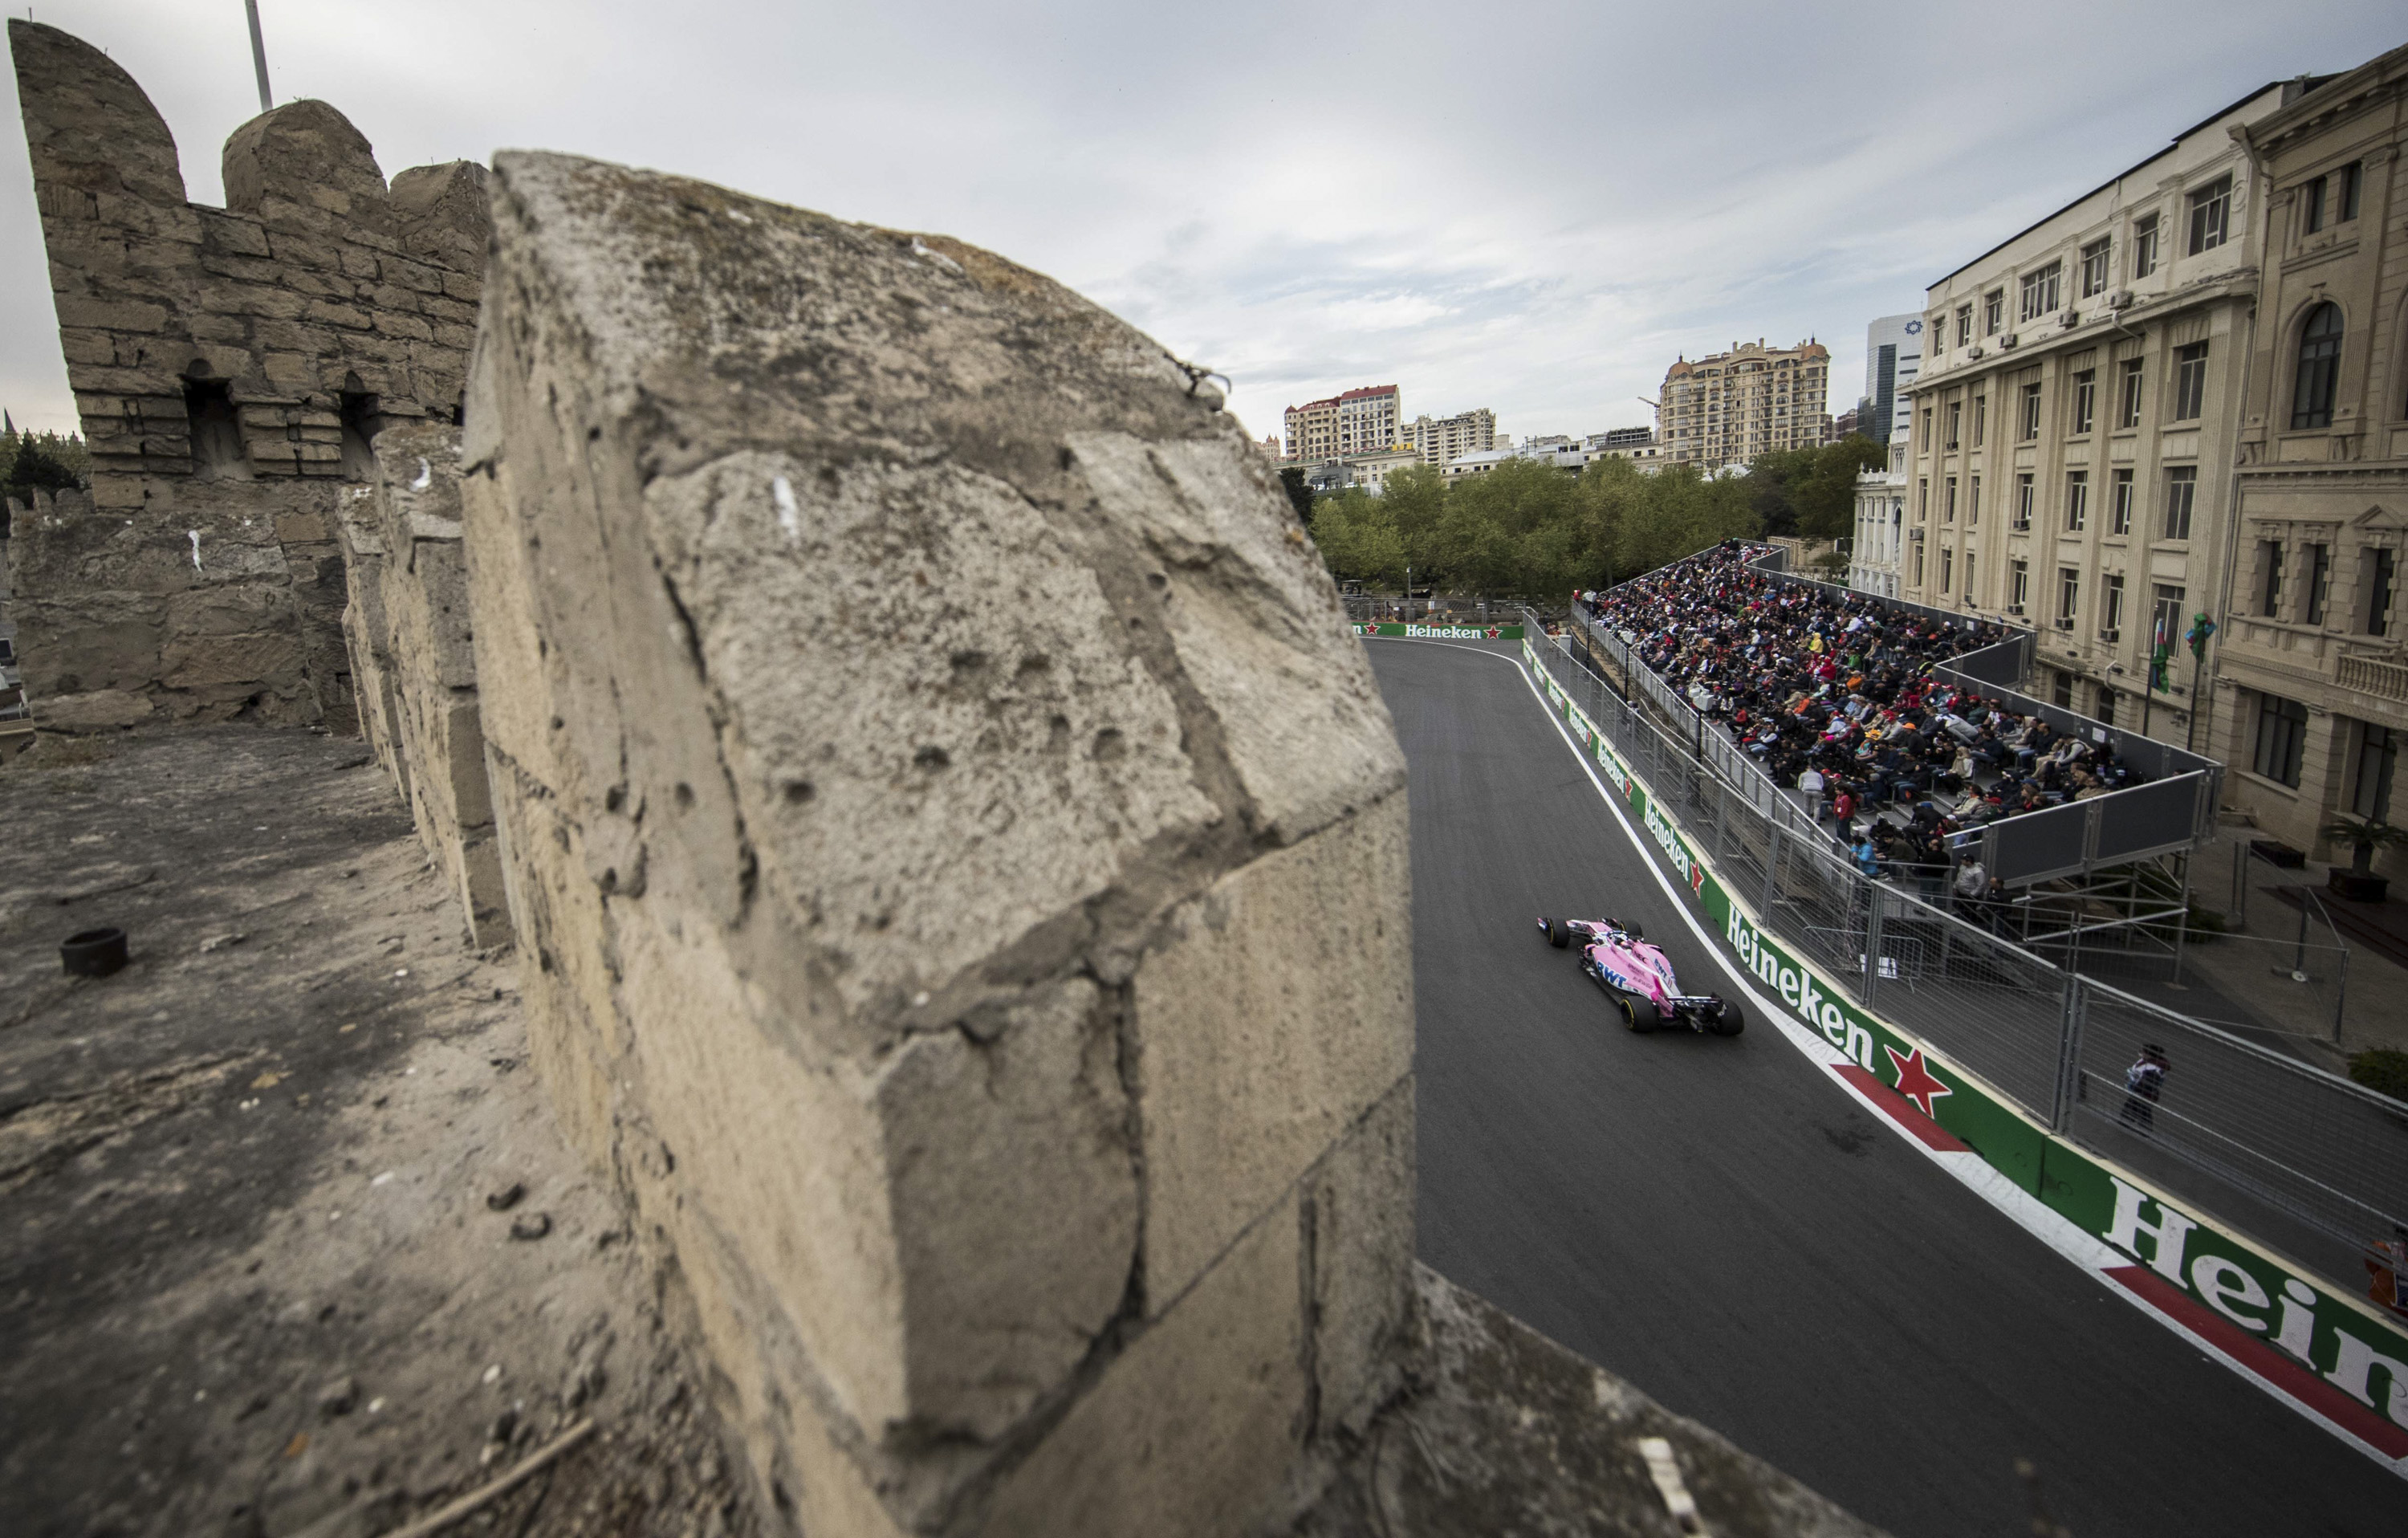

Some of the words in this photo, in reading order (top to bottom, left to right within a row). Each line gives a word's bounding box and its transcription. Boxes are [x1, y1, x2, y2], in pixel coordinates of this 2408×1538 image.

[1405, 625, 1482, 639] Heineken
[1645, 796, 1689, 881] Heineken
[1597, 961, 1627, 988] BWT
[1727, 901, 1875, 1073] Heineken
